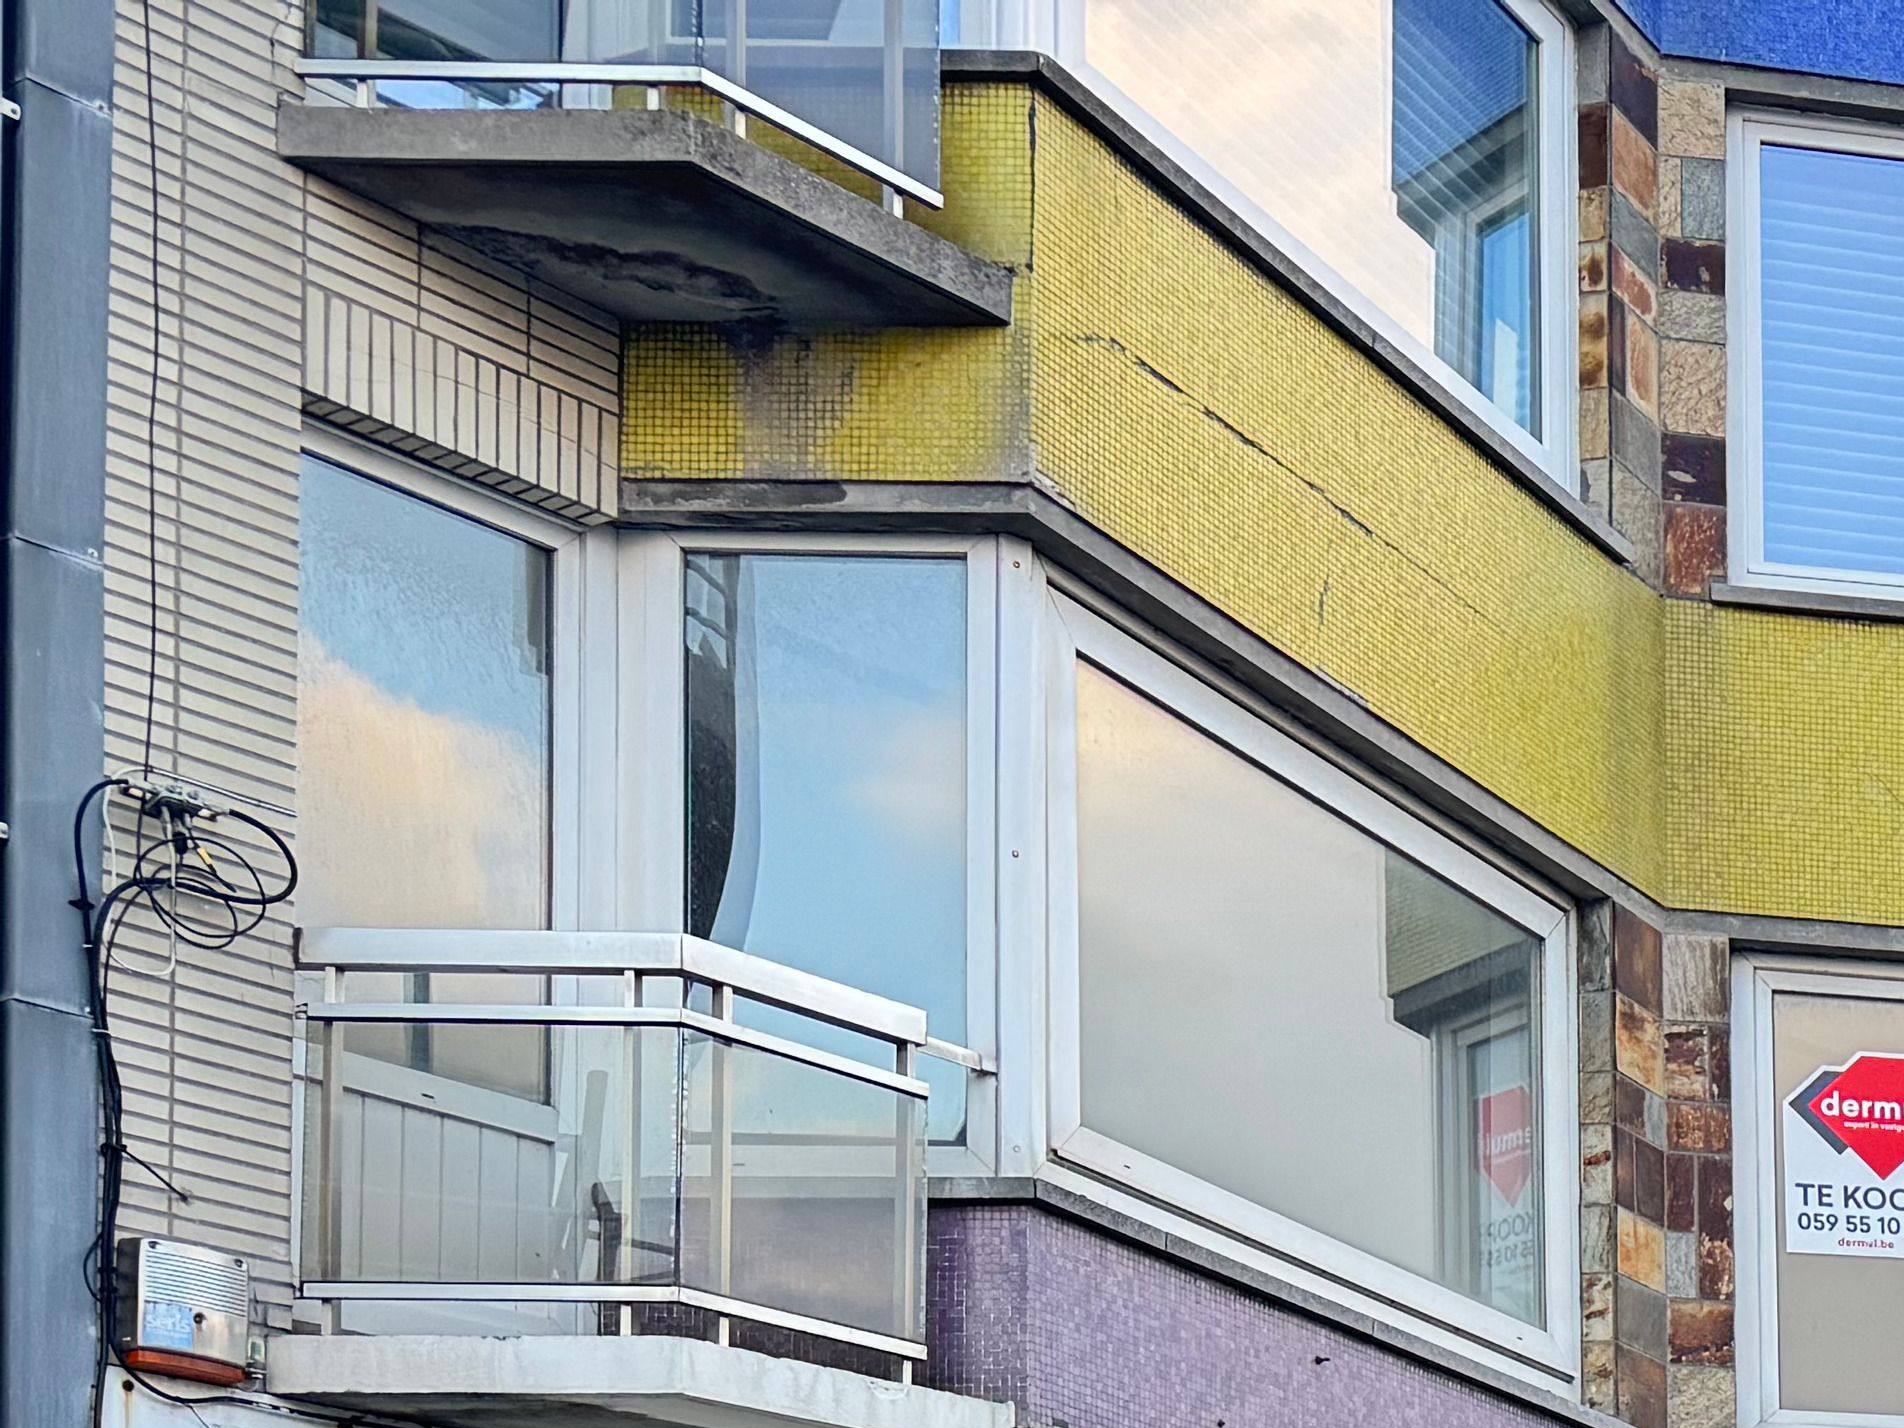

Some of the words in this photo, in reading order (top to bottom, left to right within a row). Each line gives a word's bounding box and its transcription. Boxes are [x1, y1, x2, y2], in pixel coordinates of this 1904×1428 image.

[1795, 1182, 1834, 1208] TE
[1797, 1212, 1839, 1232] 059
[1846, 1215, 1871, 1234] 55
[1877, 1216, 1901, 1236] 10
[1838, 1237, 1895, 1249] dermul.be
